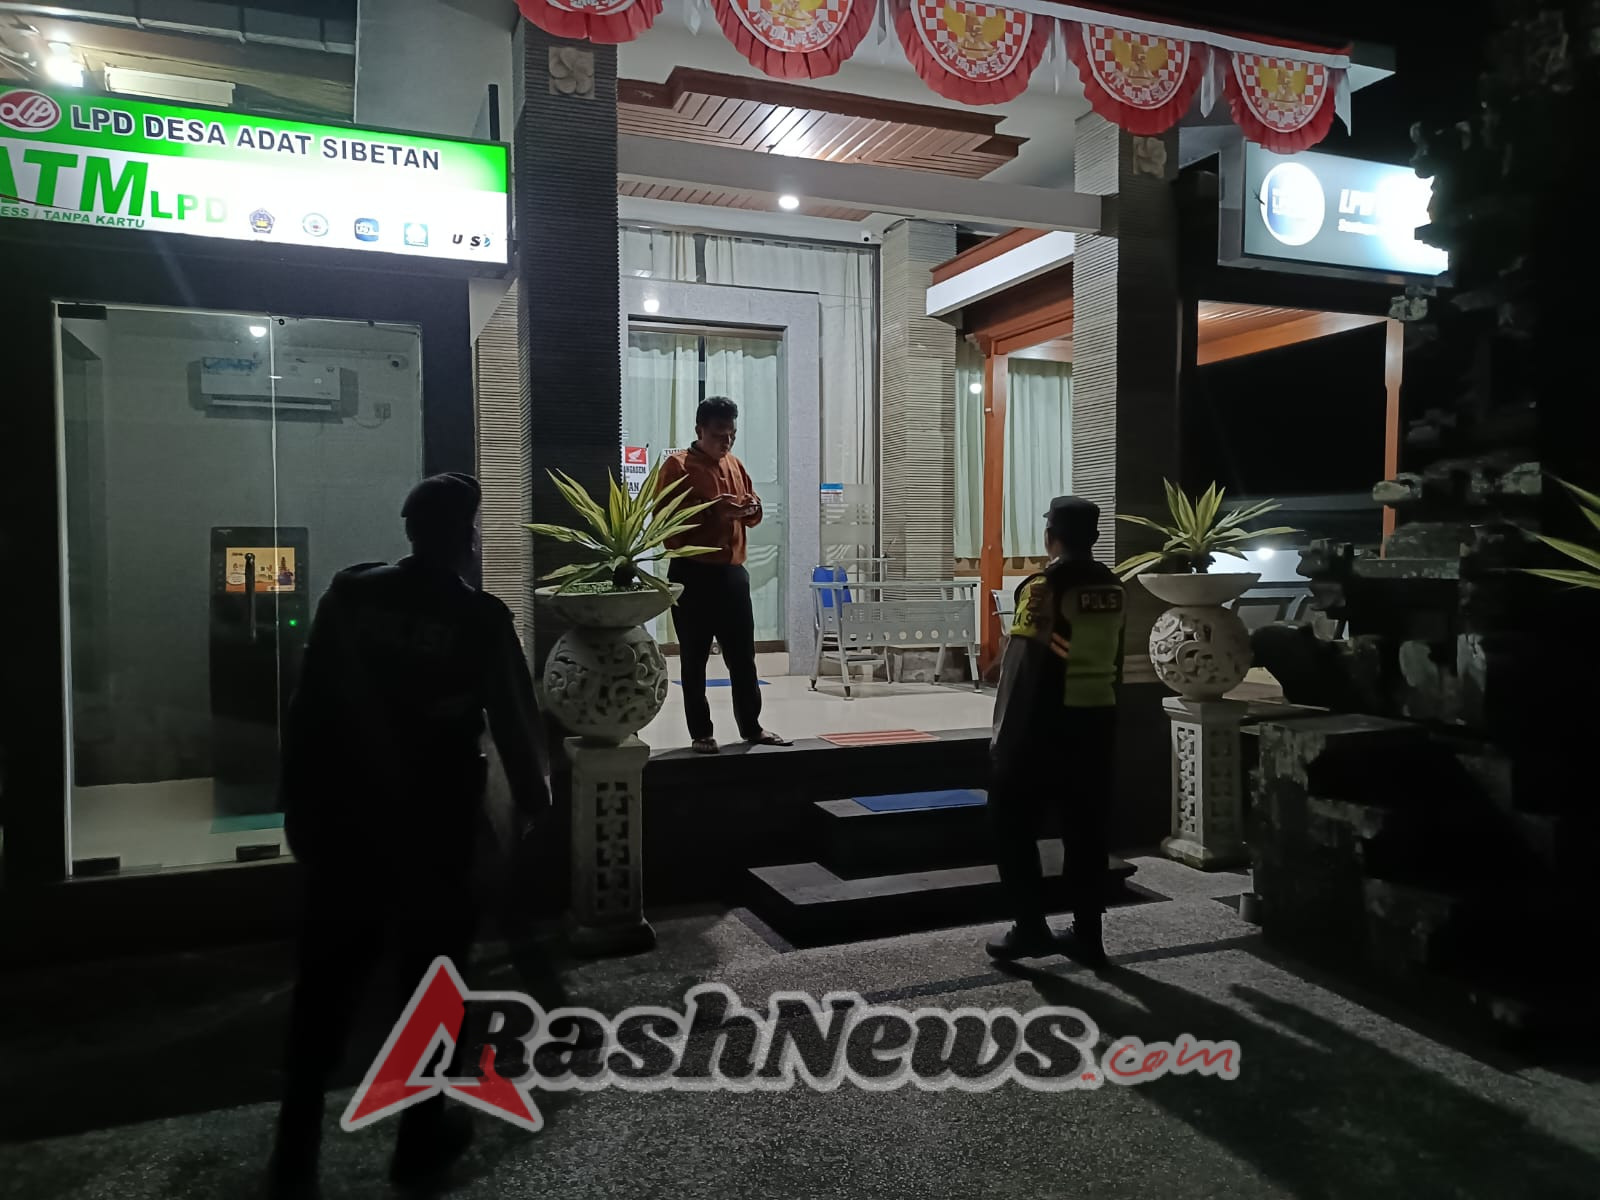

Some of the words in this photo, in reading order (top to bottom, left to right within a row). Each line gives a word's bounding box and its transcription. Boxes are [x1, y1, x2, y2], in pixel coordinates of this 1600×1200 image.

[71, 105, 134, 135] LPD
[144, 115, 226, 146] DESA
[236, 127, 312, 155] ADAT
[322, 138, 440, 171] SIBETAN
[43, 209, 91, 223] TANPA
[95, 214, 146, 229] KARTU
